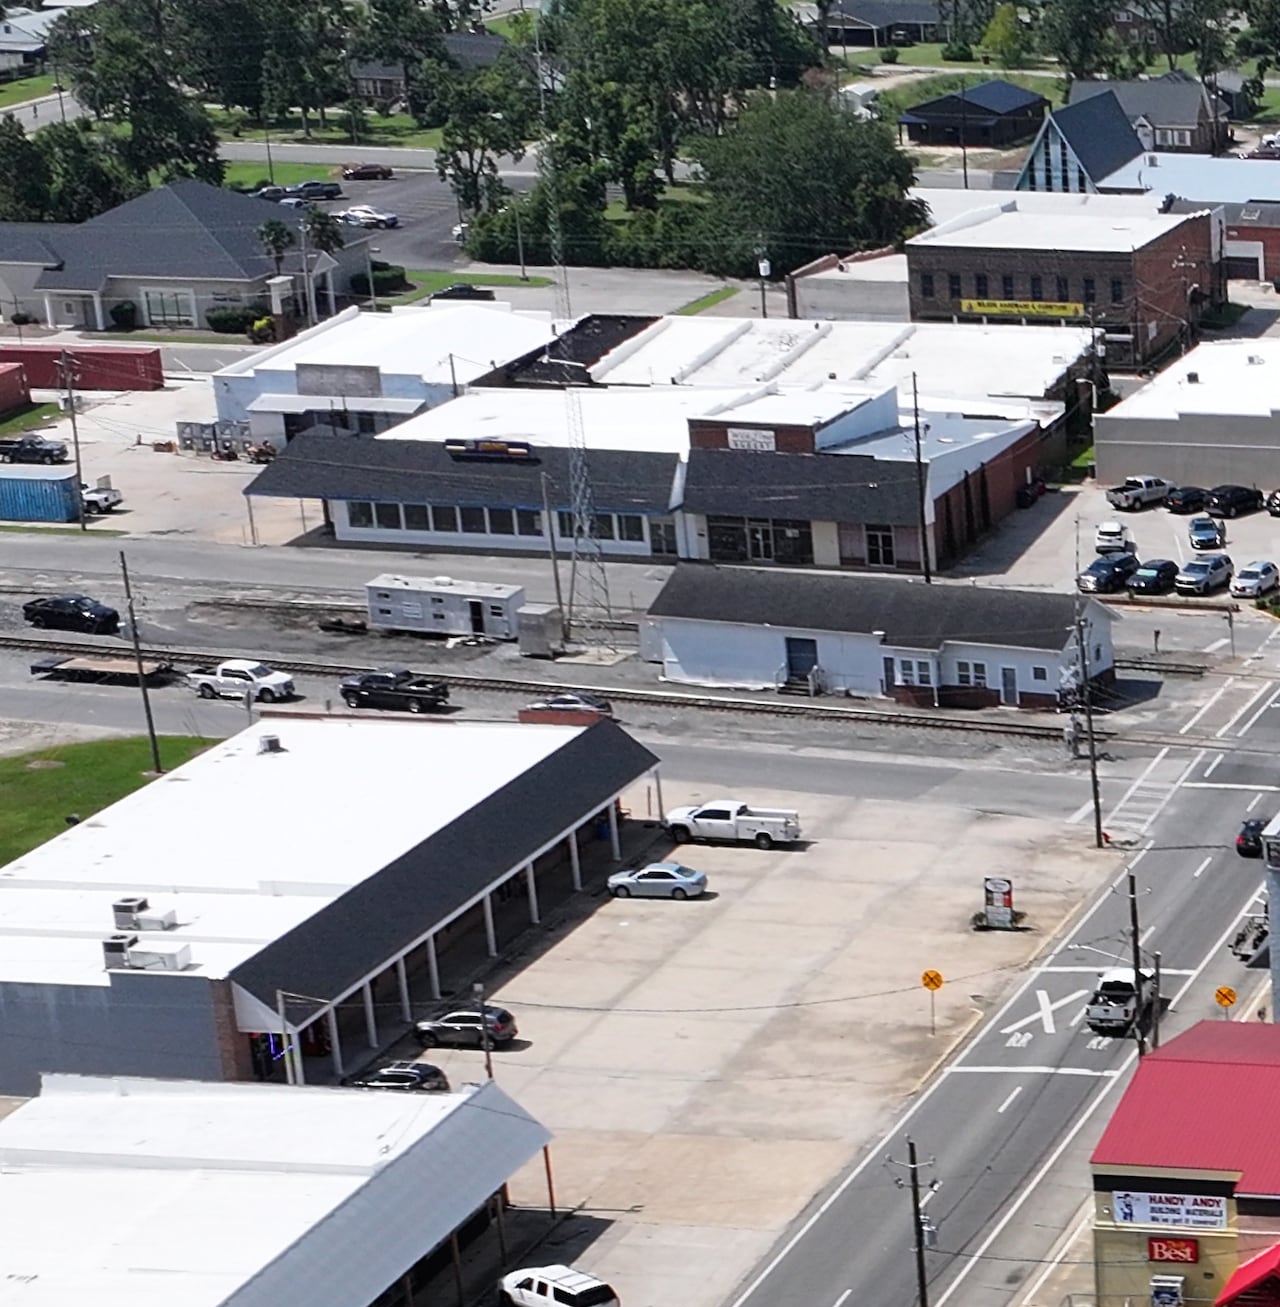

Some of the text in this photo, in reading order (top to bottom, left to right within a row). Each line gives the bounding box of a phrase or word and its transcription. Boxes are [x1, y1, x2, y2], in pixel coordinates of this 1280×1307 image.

[1149, 1196, 1221, 1208] HANDY ANDY
[1150, 1206, 1223, 1218] BUILDING MATERIALS
[1152, 1241, 1195, 1261] Best
